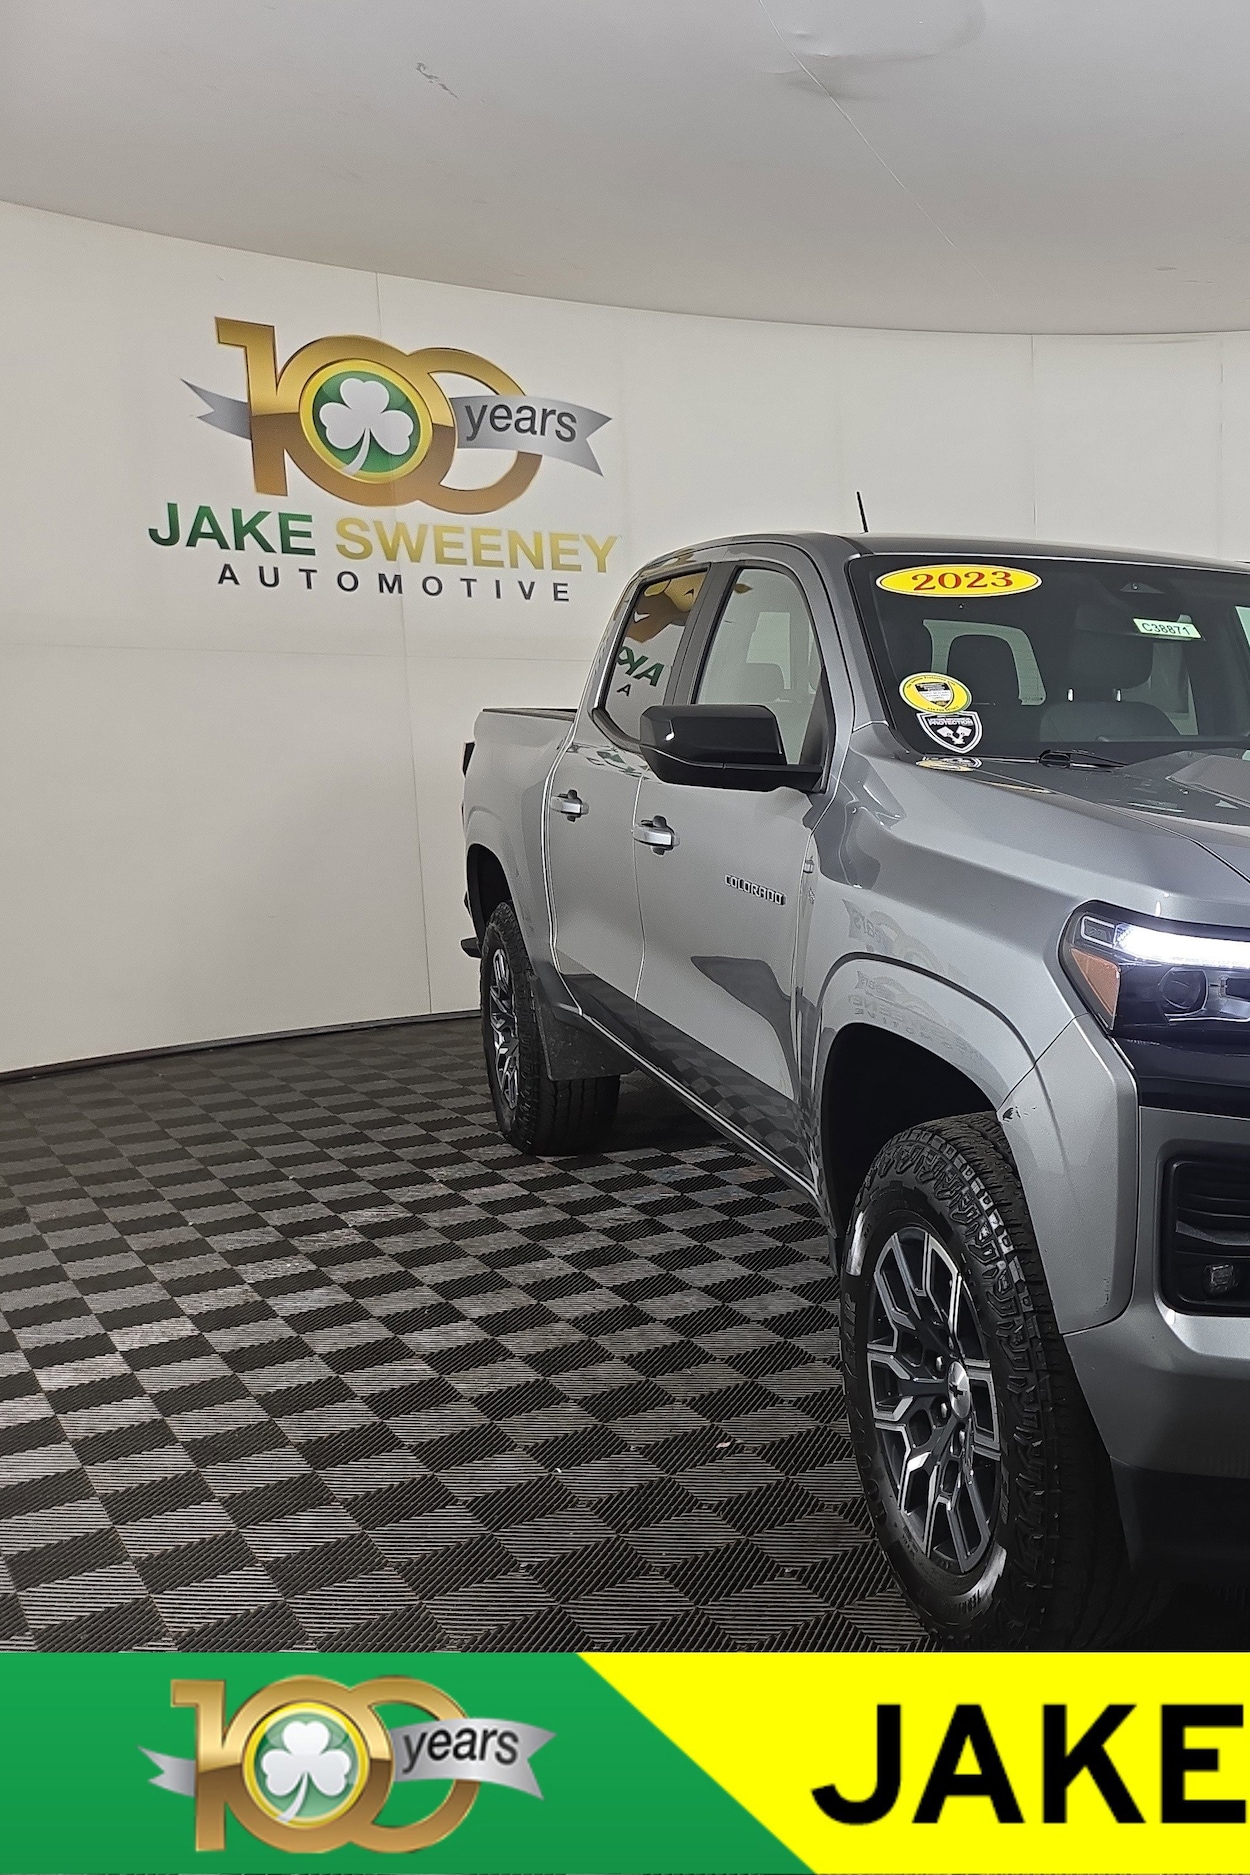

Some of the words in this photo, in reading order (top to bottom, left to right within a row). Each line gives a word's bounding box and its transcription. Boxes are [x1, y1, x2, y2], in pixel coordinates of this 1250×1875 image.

[465, 401, 578, 442] years
[148, 502, 316, 556] JAKE
[335, 516, 619, 574] SWEENEY
[217, 563, 570, 602] AUTOMOTIVE
[911, 570, 1014, 592] 2023
[1141, 622, 1191, 636] C38871
[724, 873, 785, 905] COLORADO
